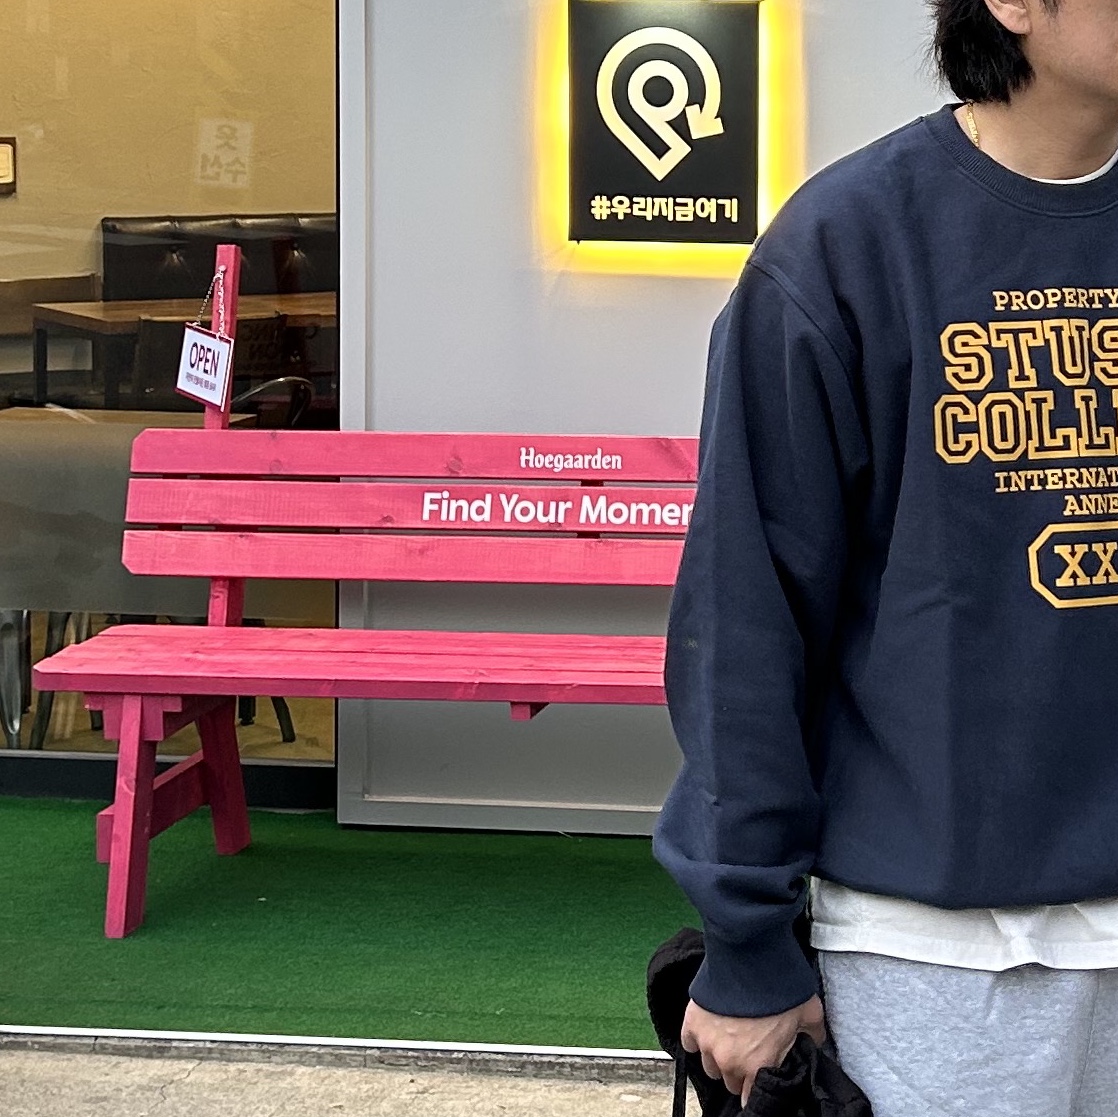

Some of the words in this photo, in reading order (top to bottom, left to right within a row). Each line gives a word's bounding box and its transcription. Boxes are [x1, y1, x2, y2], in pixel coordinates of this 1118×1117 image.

[590, 194, 738, 223] #우리지금여기
[189, 342, 220, 378] OPEN
[519, 447, 623, 473] Hoegaarden
[422, 490, 492, 522] Find
[499, 493, 572, 524] Your
